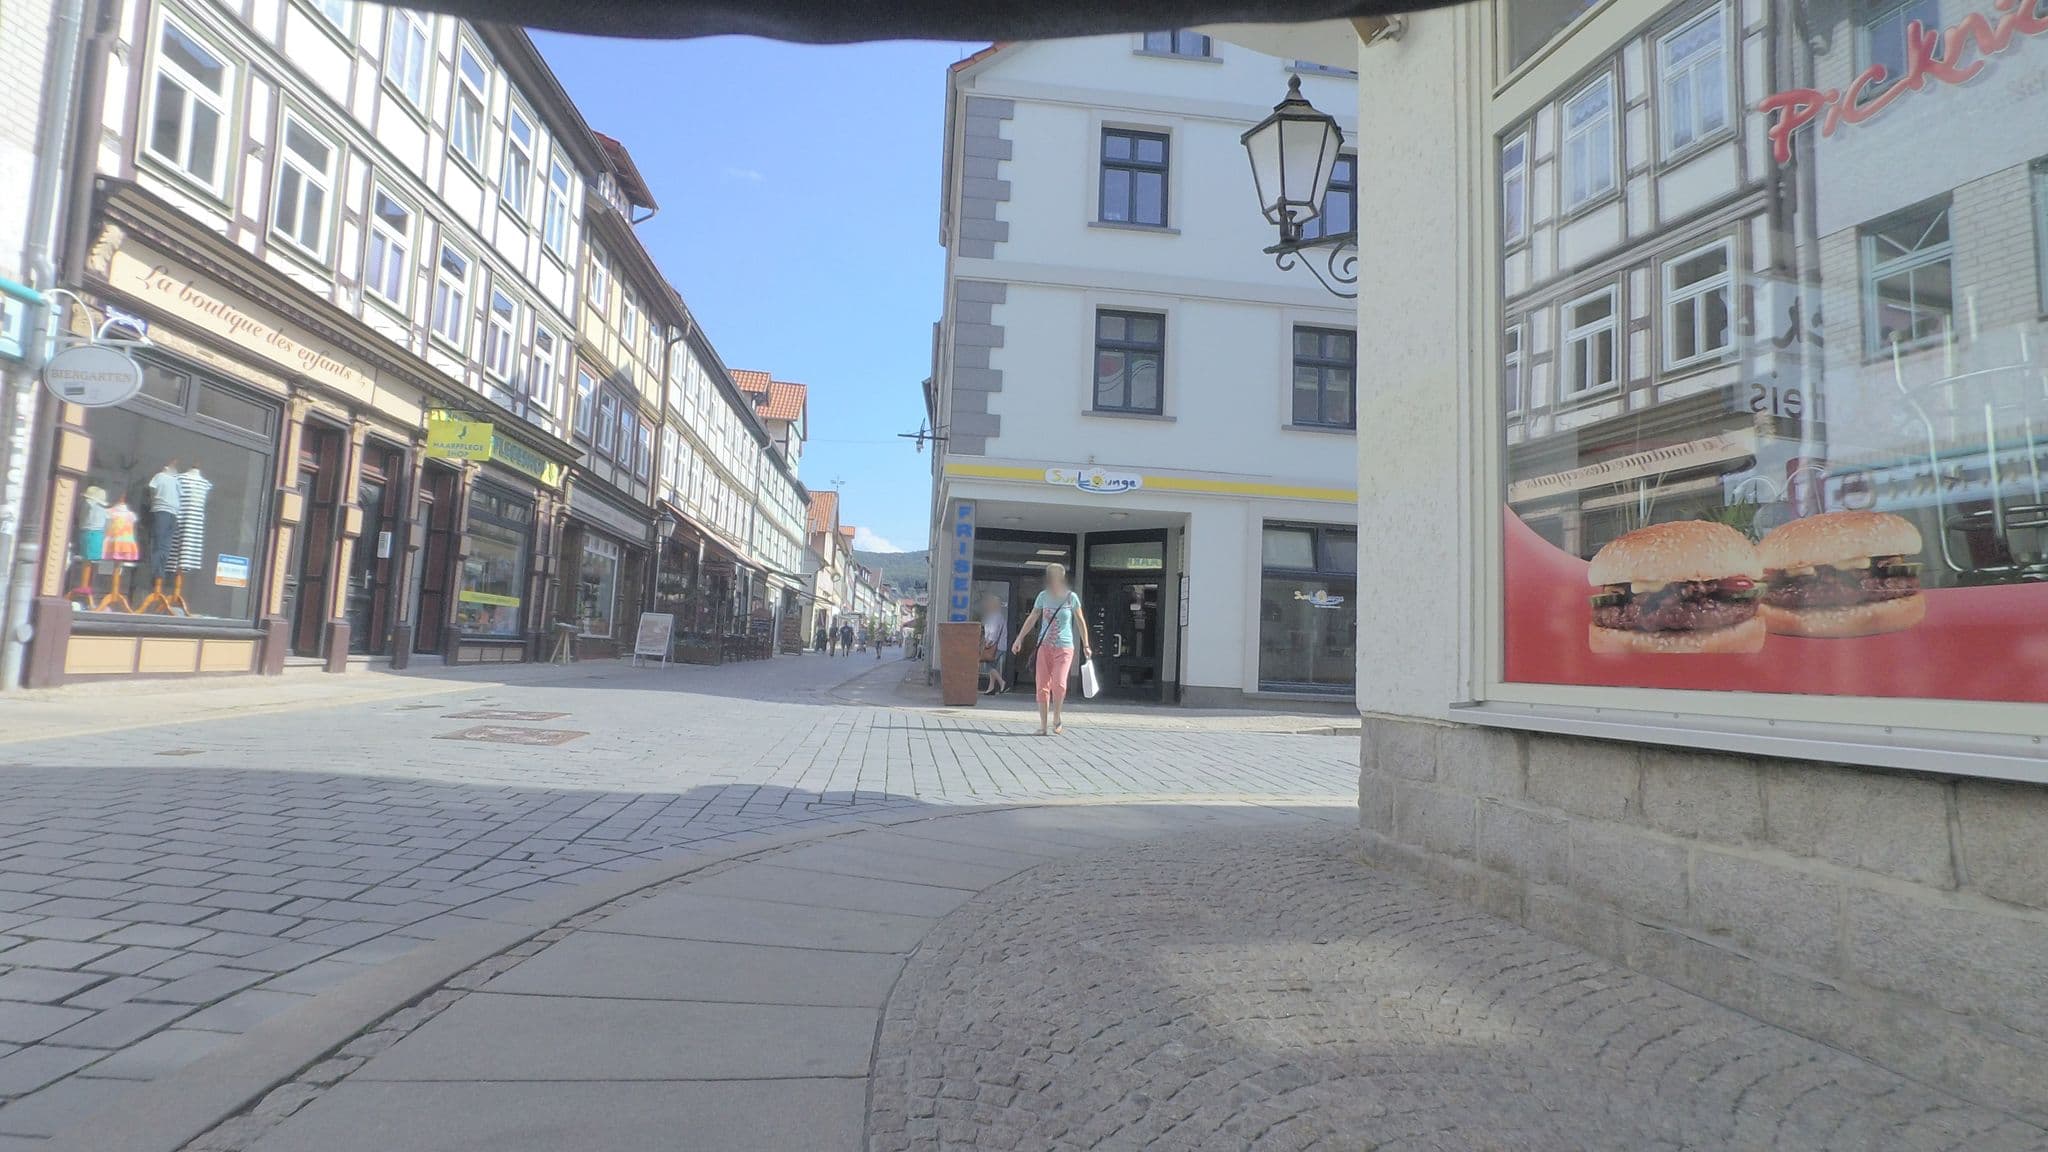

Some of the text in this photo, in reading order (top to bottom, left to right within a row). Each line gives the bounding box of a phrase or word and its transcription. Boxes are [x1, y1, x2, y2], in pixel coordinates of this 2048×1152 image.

[136, 264, 171, 293] La
[178, 280, 264, 335] boutique
[265, 326, 293, 353] des
[296, 344, 354, 381] enfants
[51, 368, 133, 384] BIERGARTEN
[432, 442, 484, 451] HAARPFLEGE
